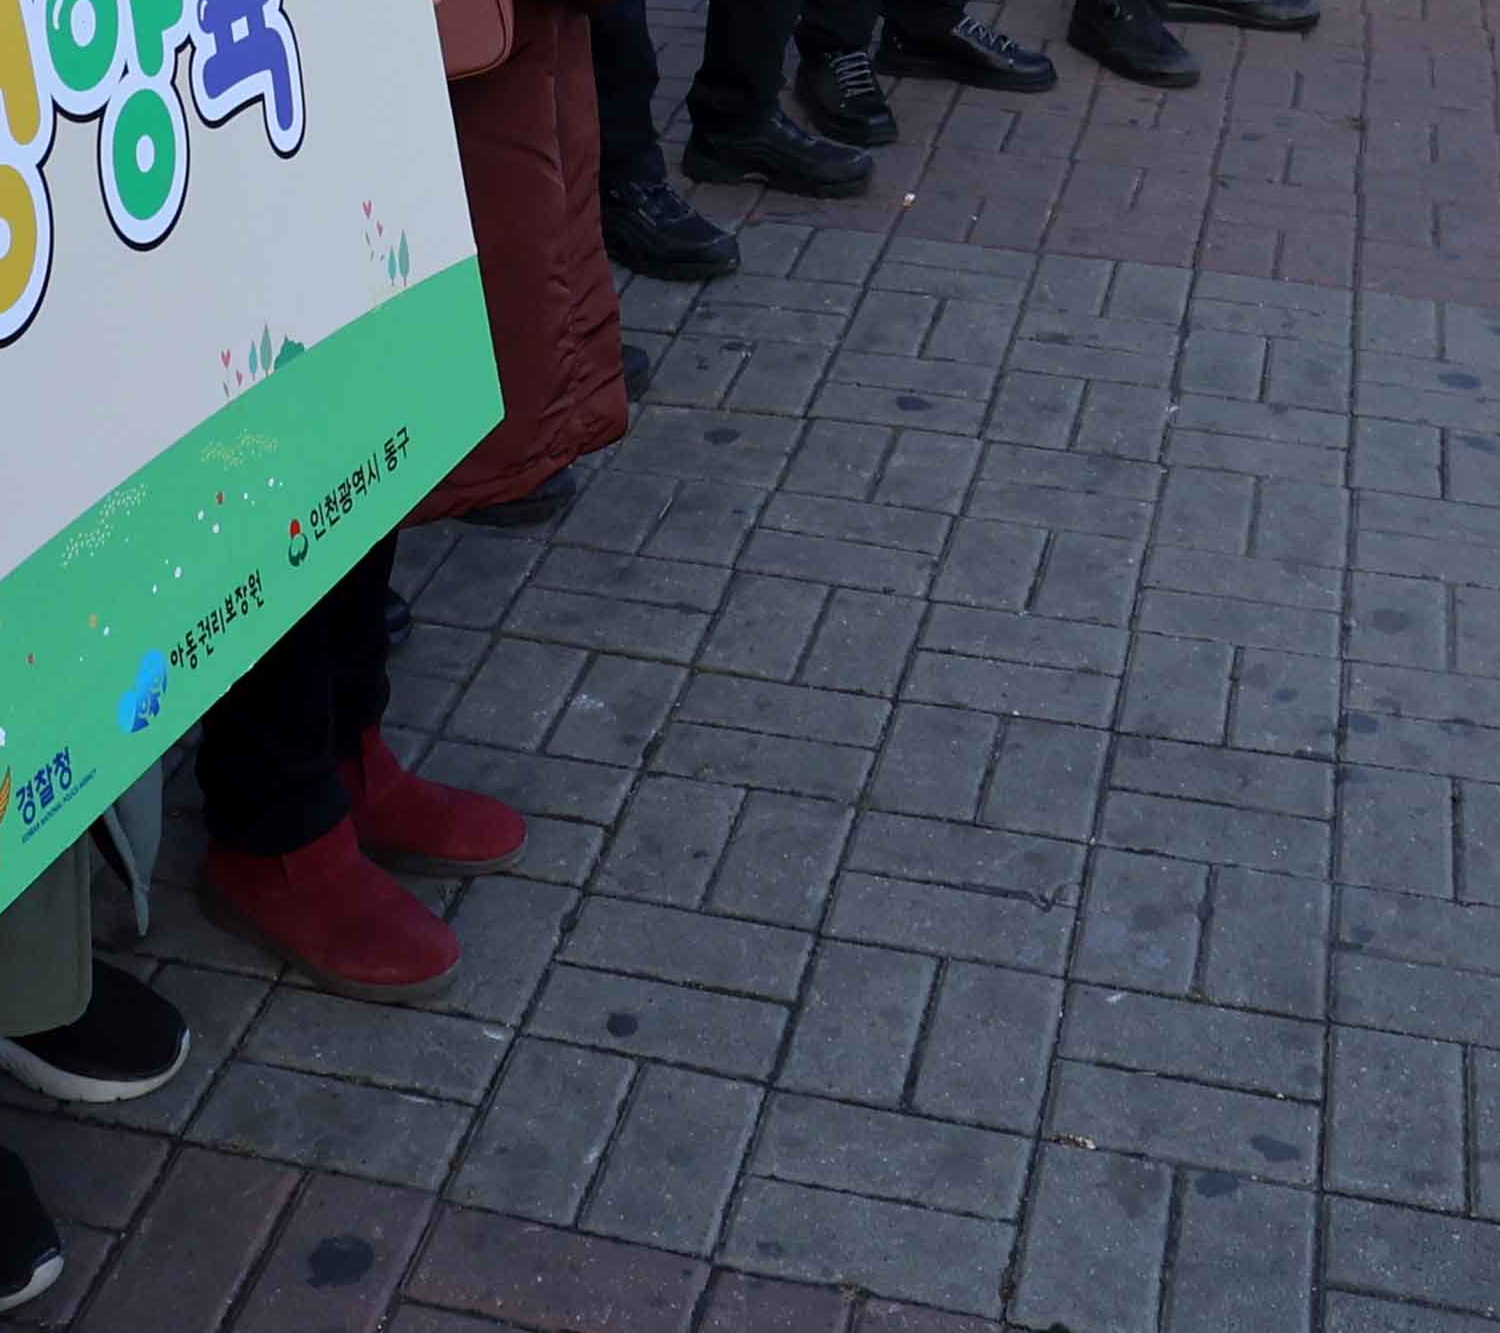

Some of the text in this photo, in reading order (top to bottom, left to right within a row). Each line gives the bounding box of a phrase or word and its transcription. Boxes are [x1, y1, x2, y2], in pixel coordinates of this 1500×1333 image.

[309, 426, 410, 541] 인천광역시 동구
[170, 569, 264, 670] 아동권리보장원
[15, 746, 73, 825] 경찰청
